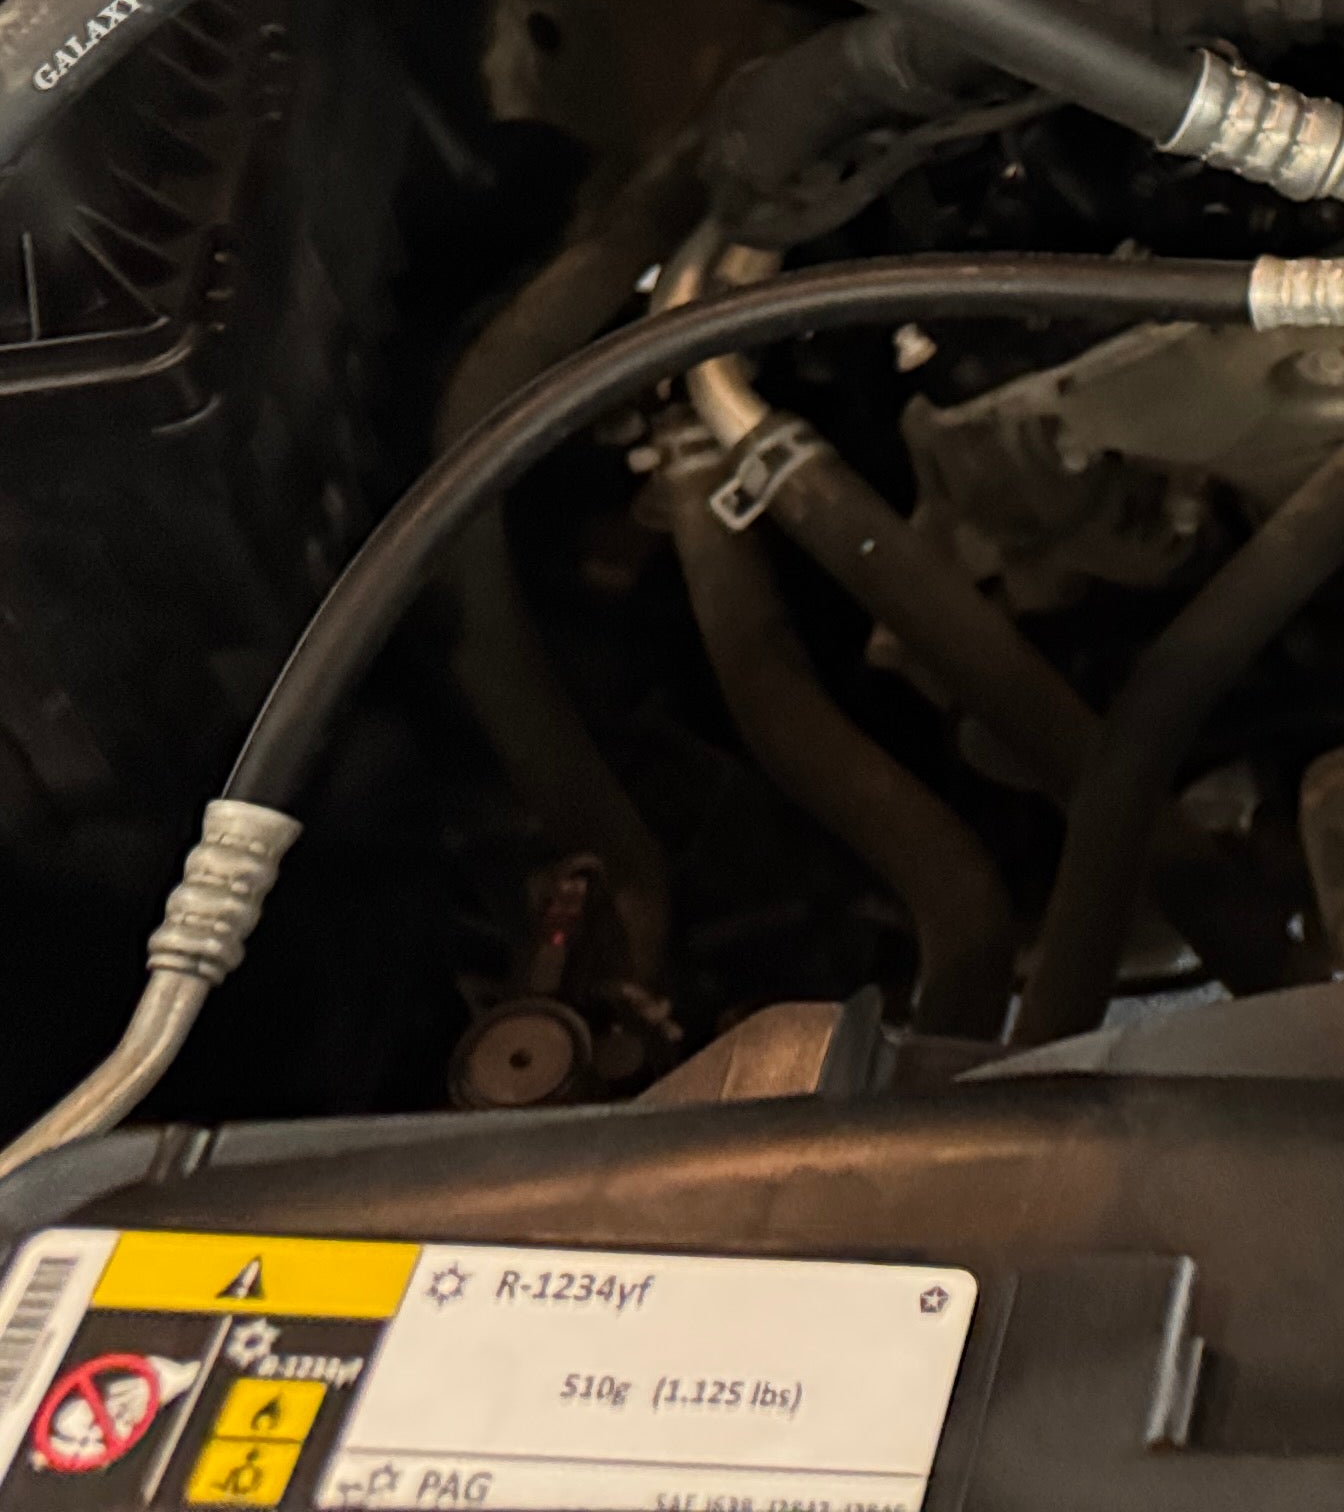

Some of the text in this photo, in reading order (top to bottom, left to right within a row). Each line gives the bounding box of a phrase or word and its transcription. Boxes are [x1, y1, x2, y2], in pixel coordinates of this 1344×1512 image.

[494, 1269, 656, 1311] R-1234yf
[558, 1373, 803, 1415] 510g (1.125 lbs)
[415, 1468, 493, 1502] PAG
